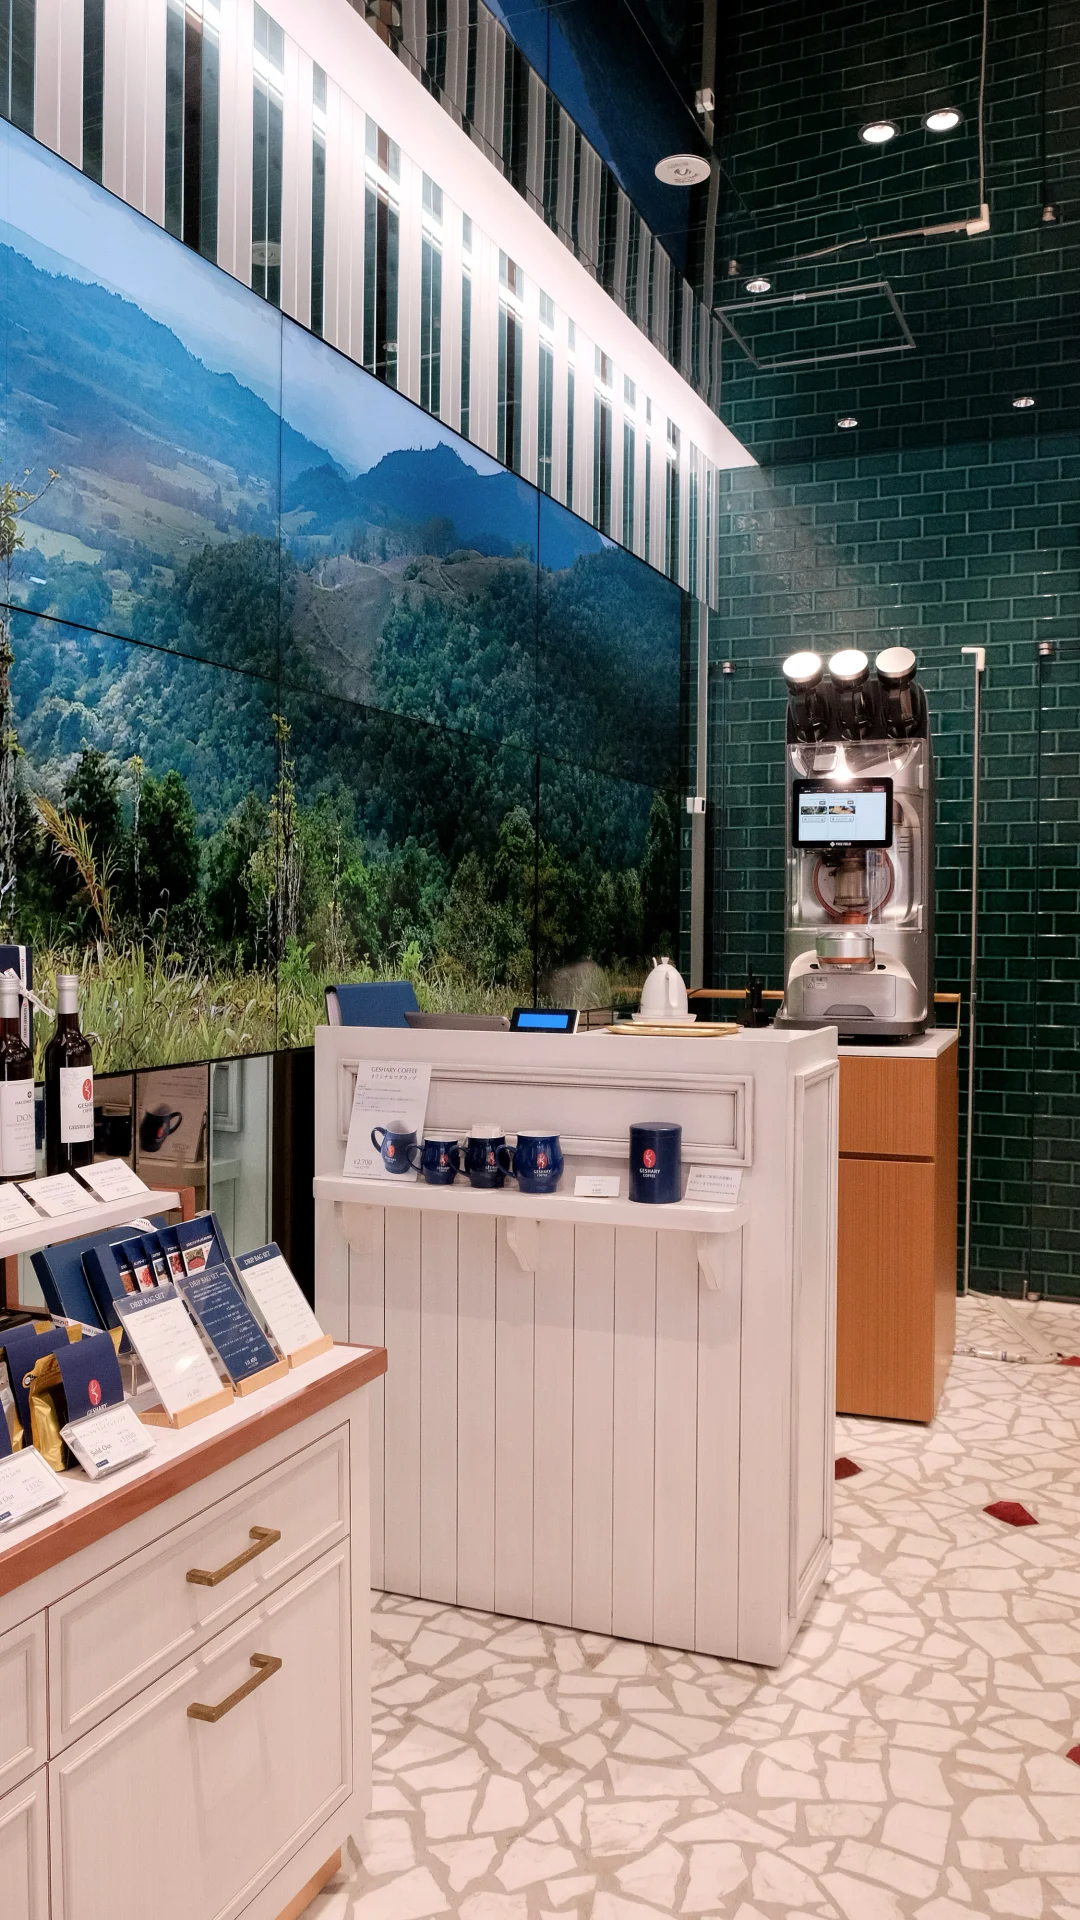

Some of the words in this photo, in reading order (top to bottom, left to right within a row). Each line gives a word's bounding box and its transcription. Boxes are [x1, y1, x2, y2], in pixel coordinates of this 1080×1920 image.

[371, 1066, 397, 1074] GESHARY
[397, 1067, 419, 1075] COFFEE
[371, 1073, 417, 1081] オリジナルマグカップ
[243, 1256, 255, 1266] DRIP
[253, 1253, 264, 1262] BAG
[262, 1250, 271, 1259] SET
[189, 1278, 201, 1288] DRIP
[201, 1274, 212, 1284] BAG
[211, 1271, 220, 1281] SET
[129, 1300, 144, 1310] DRIP
[144, 1296, 156, 1306] BAG
[155, 1292, 166, 1302] SET
[90, 1446, 102, 1456] Sold
[102, 1443, 113, 1451] Out
